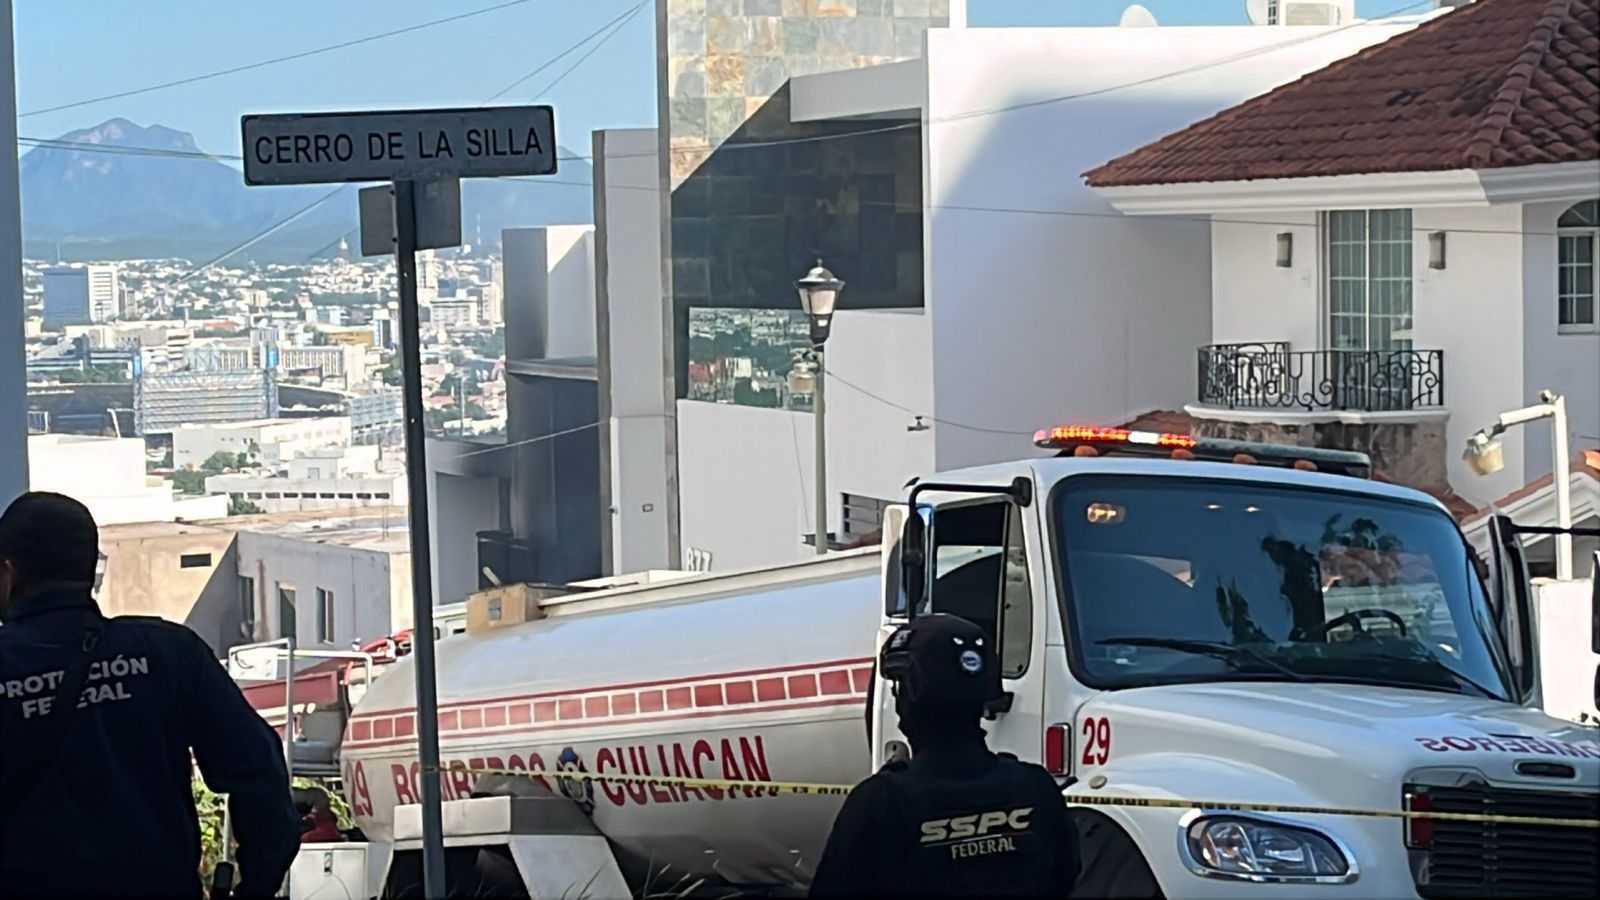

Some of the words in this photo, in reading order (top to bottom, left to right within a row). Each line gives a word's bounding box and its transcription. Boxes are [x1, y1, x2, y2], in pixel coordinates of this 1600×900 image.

[255, 134, 353, 164] CERRO
[368, 132, 404, 160] DE
[418, 131, 454, 159] LA
[466, 127, 542, 157] SILLA
[0, 654, 149, 698] ROTCIÓN
[22, 682, 132, 719] FERAL
[1082, 717, 1111, 765] 29
[345, 760, 374, 817] 29
[919, 807, 1035, 843] SSPC
[951, 836, 1016, 859] FEDERAL
